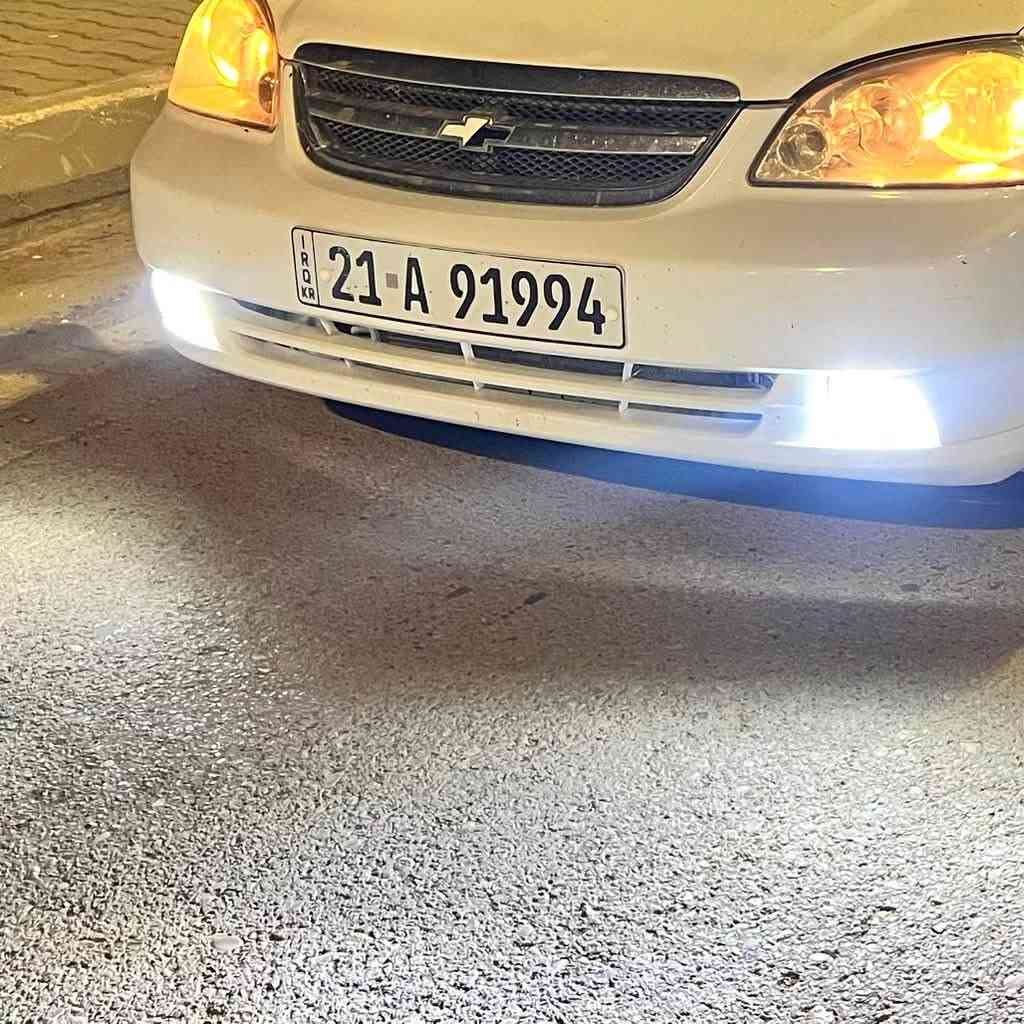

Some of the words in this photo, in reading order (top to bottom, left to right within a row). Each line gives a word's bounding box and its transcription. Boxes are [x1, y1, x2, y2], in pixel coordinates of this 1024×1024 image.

[329, 246, 382, 306] 21
[404, 257, 430, 314] A
[450, 264, 606, 335] 91994
